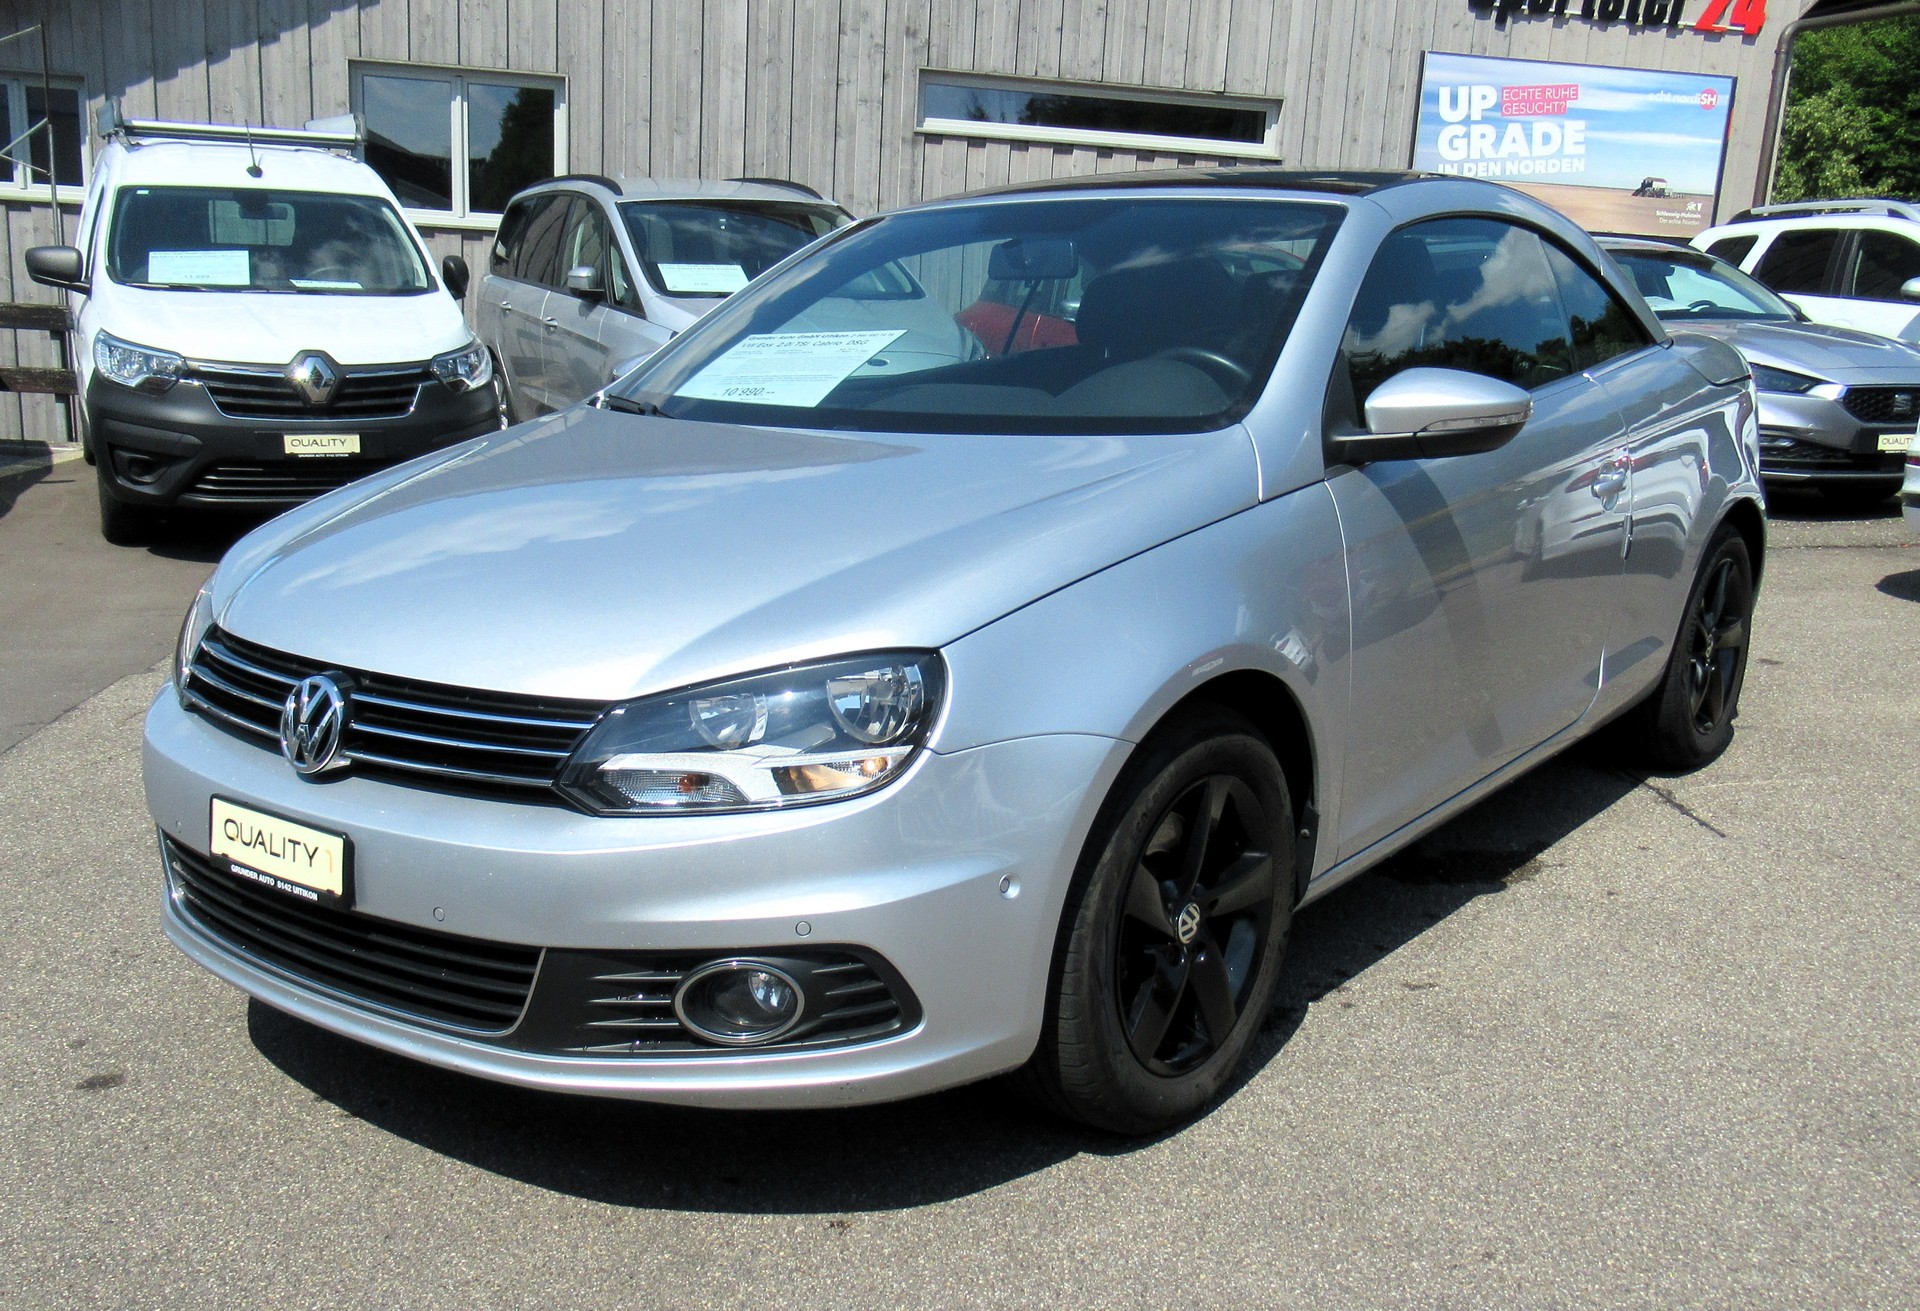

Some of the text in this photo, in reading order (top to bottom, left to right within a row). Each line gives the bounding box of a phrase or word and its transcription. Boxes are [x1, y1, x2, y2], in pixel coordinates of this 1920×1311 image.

[1502, 86, 1577, 101] ECHTE RUHE
[1438, 85, 1498, 122] UP
[1502, 101, 1566, 115] GESUCHT?
[1437, 120, 1586, 161] GRADE
[1437, 158, 1586, 177] IN DEN NORDEN
[290, 438, 347, 447] QUALITY
[1881, 437, 1914, 445] QUALIT
[223, 818, 319, 868] QUALITY
[230, 864, 259, 881] GRUNDER
[258, 874, 275, 887] AUTO
[276, 880, 292, 892] 8142
